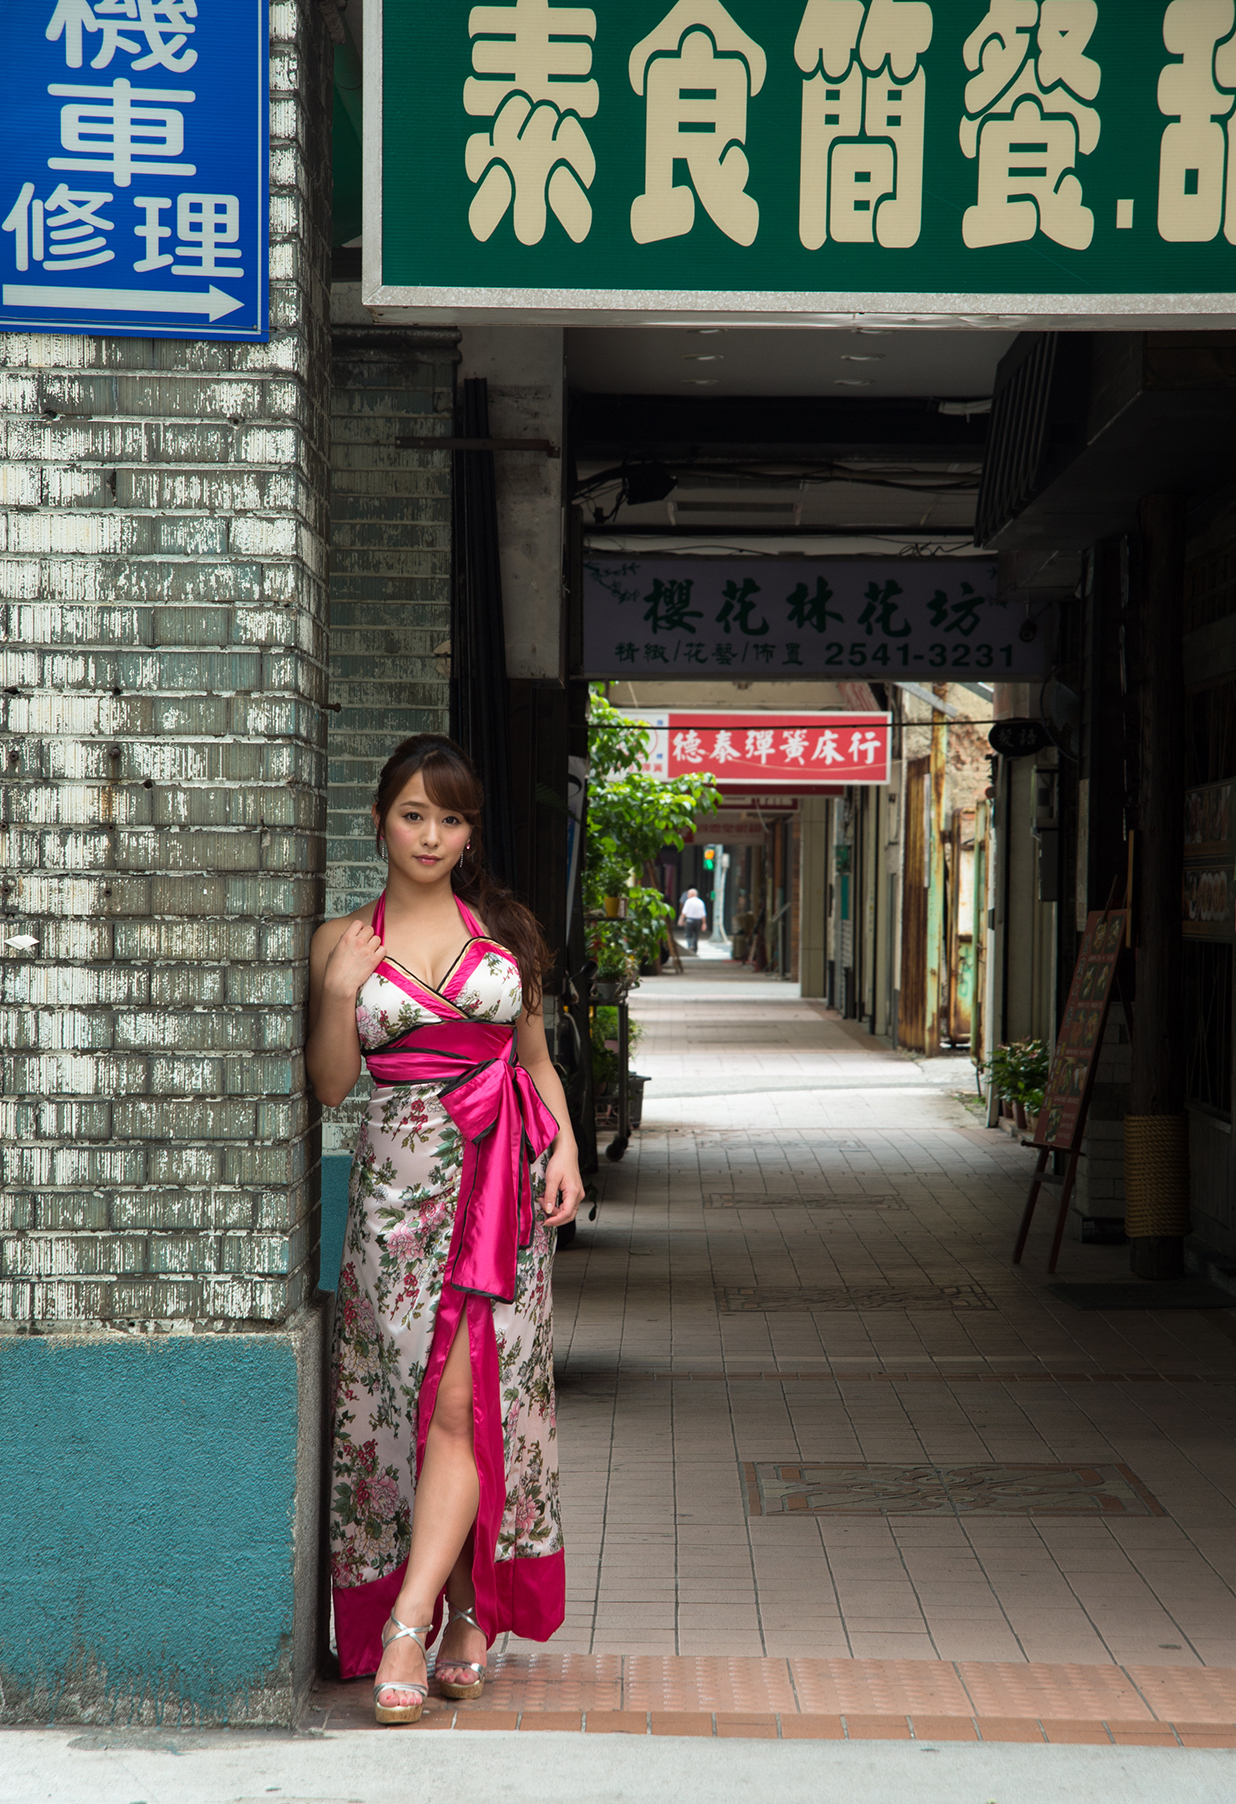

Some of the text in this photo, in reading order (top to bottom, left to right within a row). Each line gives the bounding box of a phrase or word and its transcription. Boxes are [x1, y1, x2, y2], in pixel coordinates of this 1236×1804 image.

[45, 0, 198, 188] 機車
[1, 181, 245, 278] 修理
[642, 576, 986, 638] 櫻花林花坊
[824, 641, 1014, 668] 2541-3231
[672, 728, 882, 766] 德泰彈簧床行
